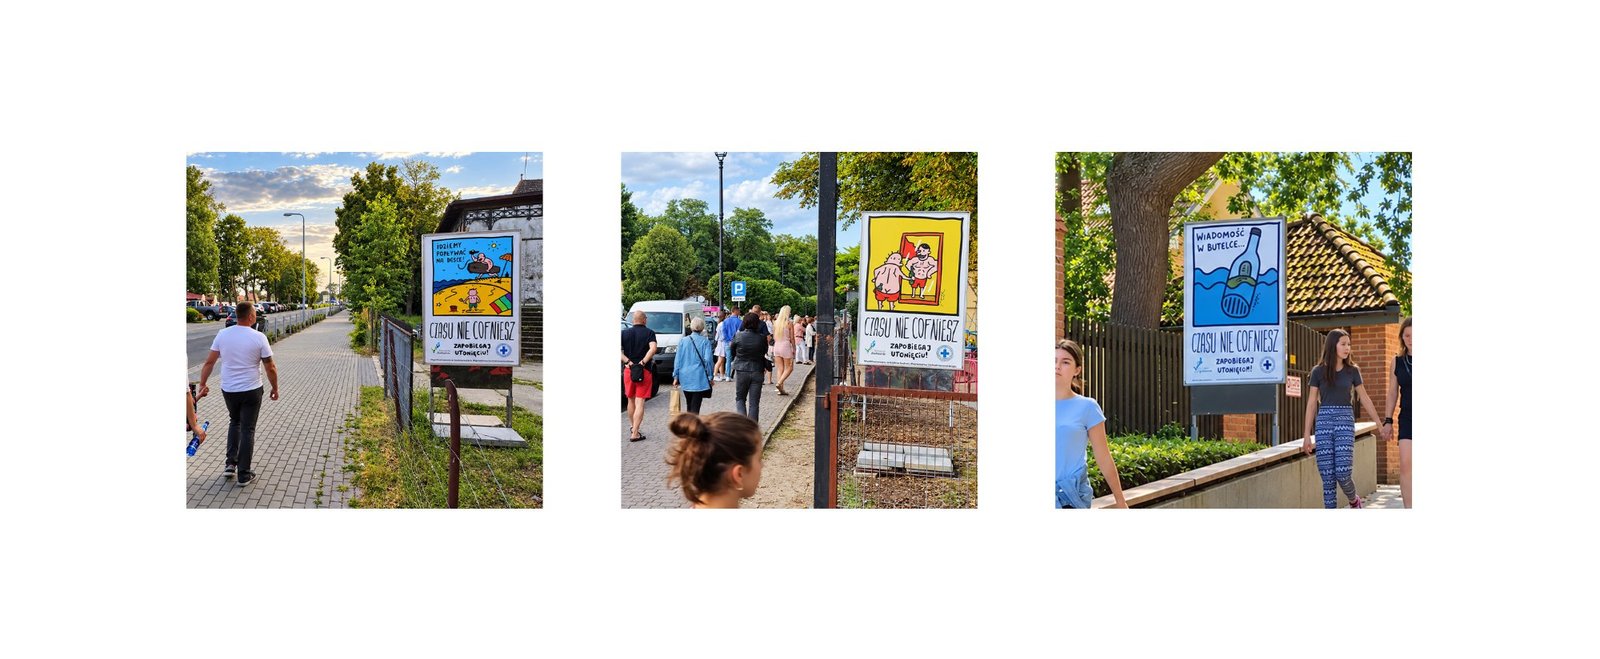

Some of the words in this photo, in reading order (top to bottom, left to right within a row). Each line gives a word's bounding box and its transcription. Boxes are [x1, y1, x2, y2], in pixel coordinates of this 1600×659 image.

[1196, 228, 1244, 241] WIADOMOŚĆ
[429, 322, 454, 340] CZASU
[457, 321, 471, 340] NIE
[473, 321, 515, 341] COFNIESZ
[864, 317, 891, 338] CZASU
[895, 316, 910, 339] NIE
[912, 317, 959, 342] COFNIESZ
[890, 343, 932, 351] ZAPOBIEGAJ
[1192, 332, 1216, 353] CZASU
[1220, 330, 1234, 354] NIE
[1236, 329, 1279, 353] COFNIESZ
[890, 351, 929, 360] UTONIĘCIU!
[1216, 357, 1254, 365] ZAPOBIEGAJ
